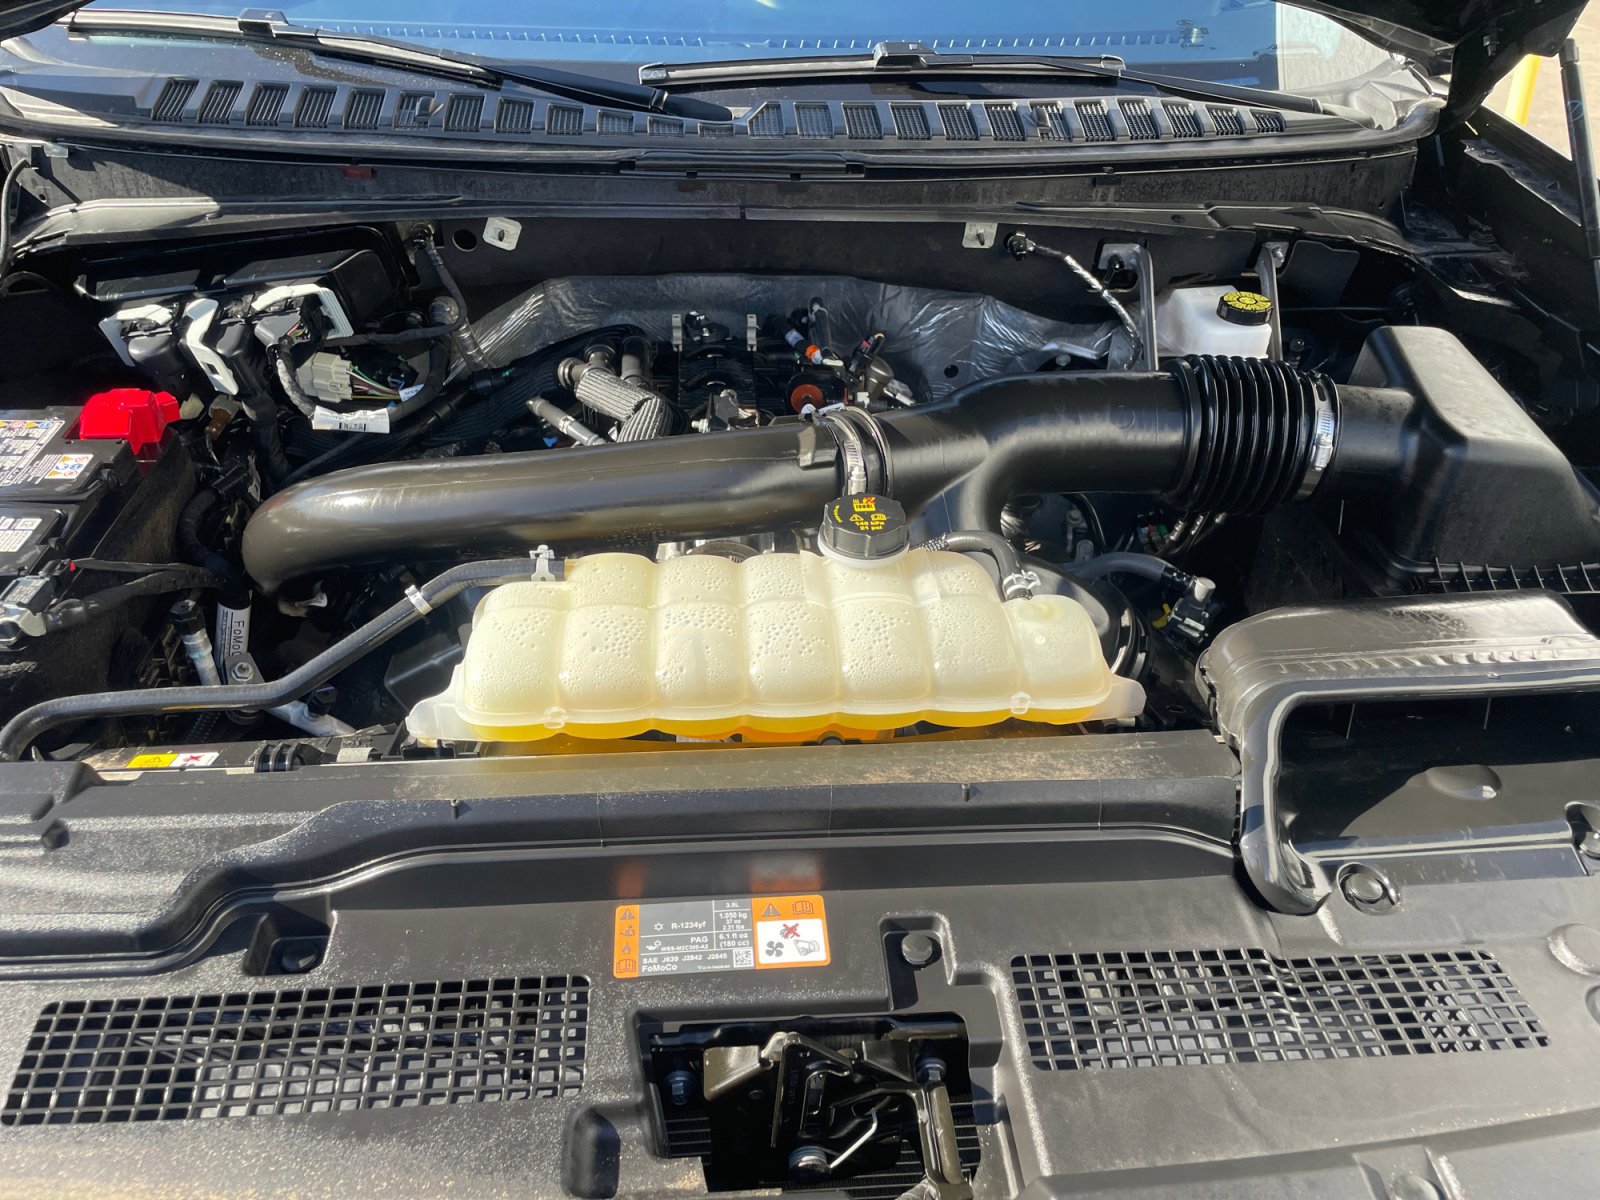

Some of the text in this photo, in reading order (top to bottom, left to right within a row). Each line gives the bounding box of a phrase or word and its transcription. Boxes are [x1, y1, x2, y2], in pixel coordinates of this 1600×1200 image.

[738, 911, 748, 920] kg
[671, 920, 707, 930] R-1234yf
[690, 935, 709, 943] PAG
[718, 932, 730, 940] 6.1
[719, 939, 750, 949] (180 cc)
[707, 952, 728, 960] J2845
[641, 963, 678, 973] FoMoCo
